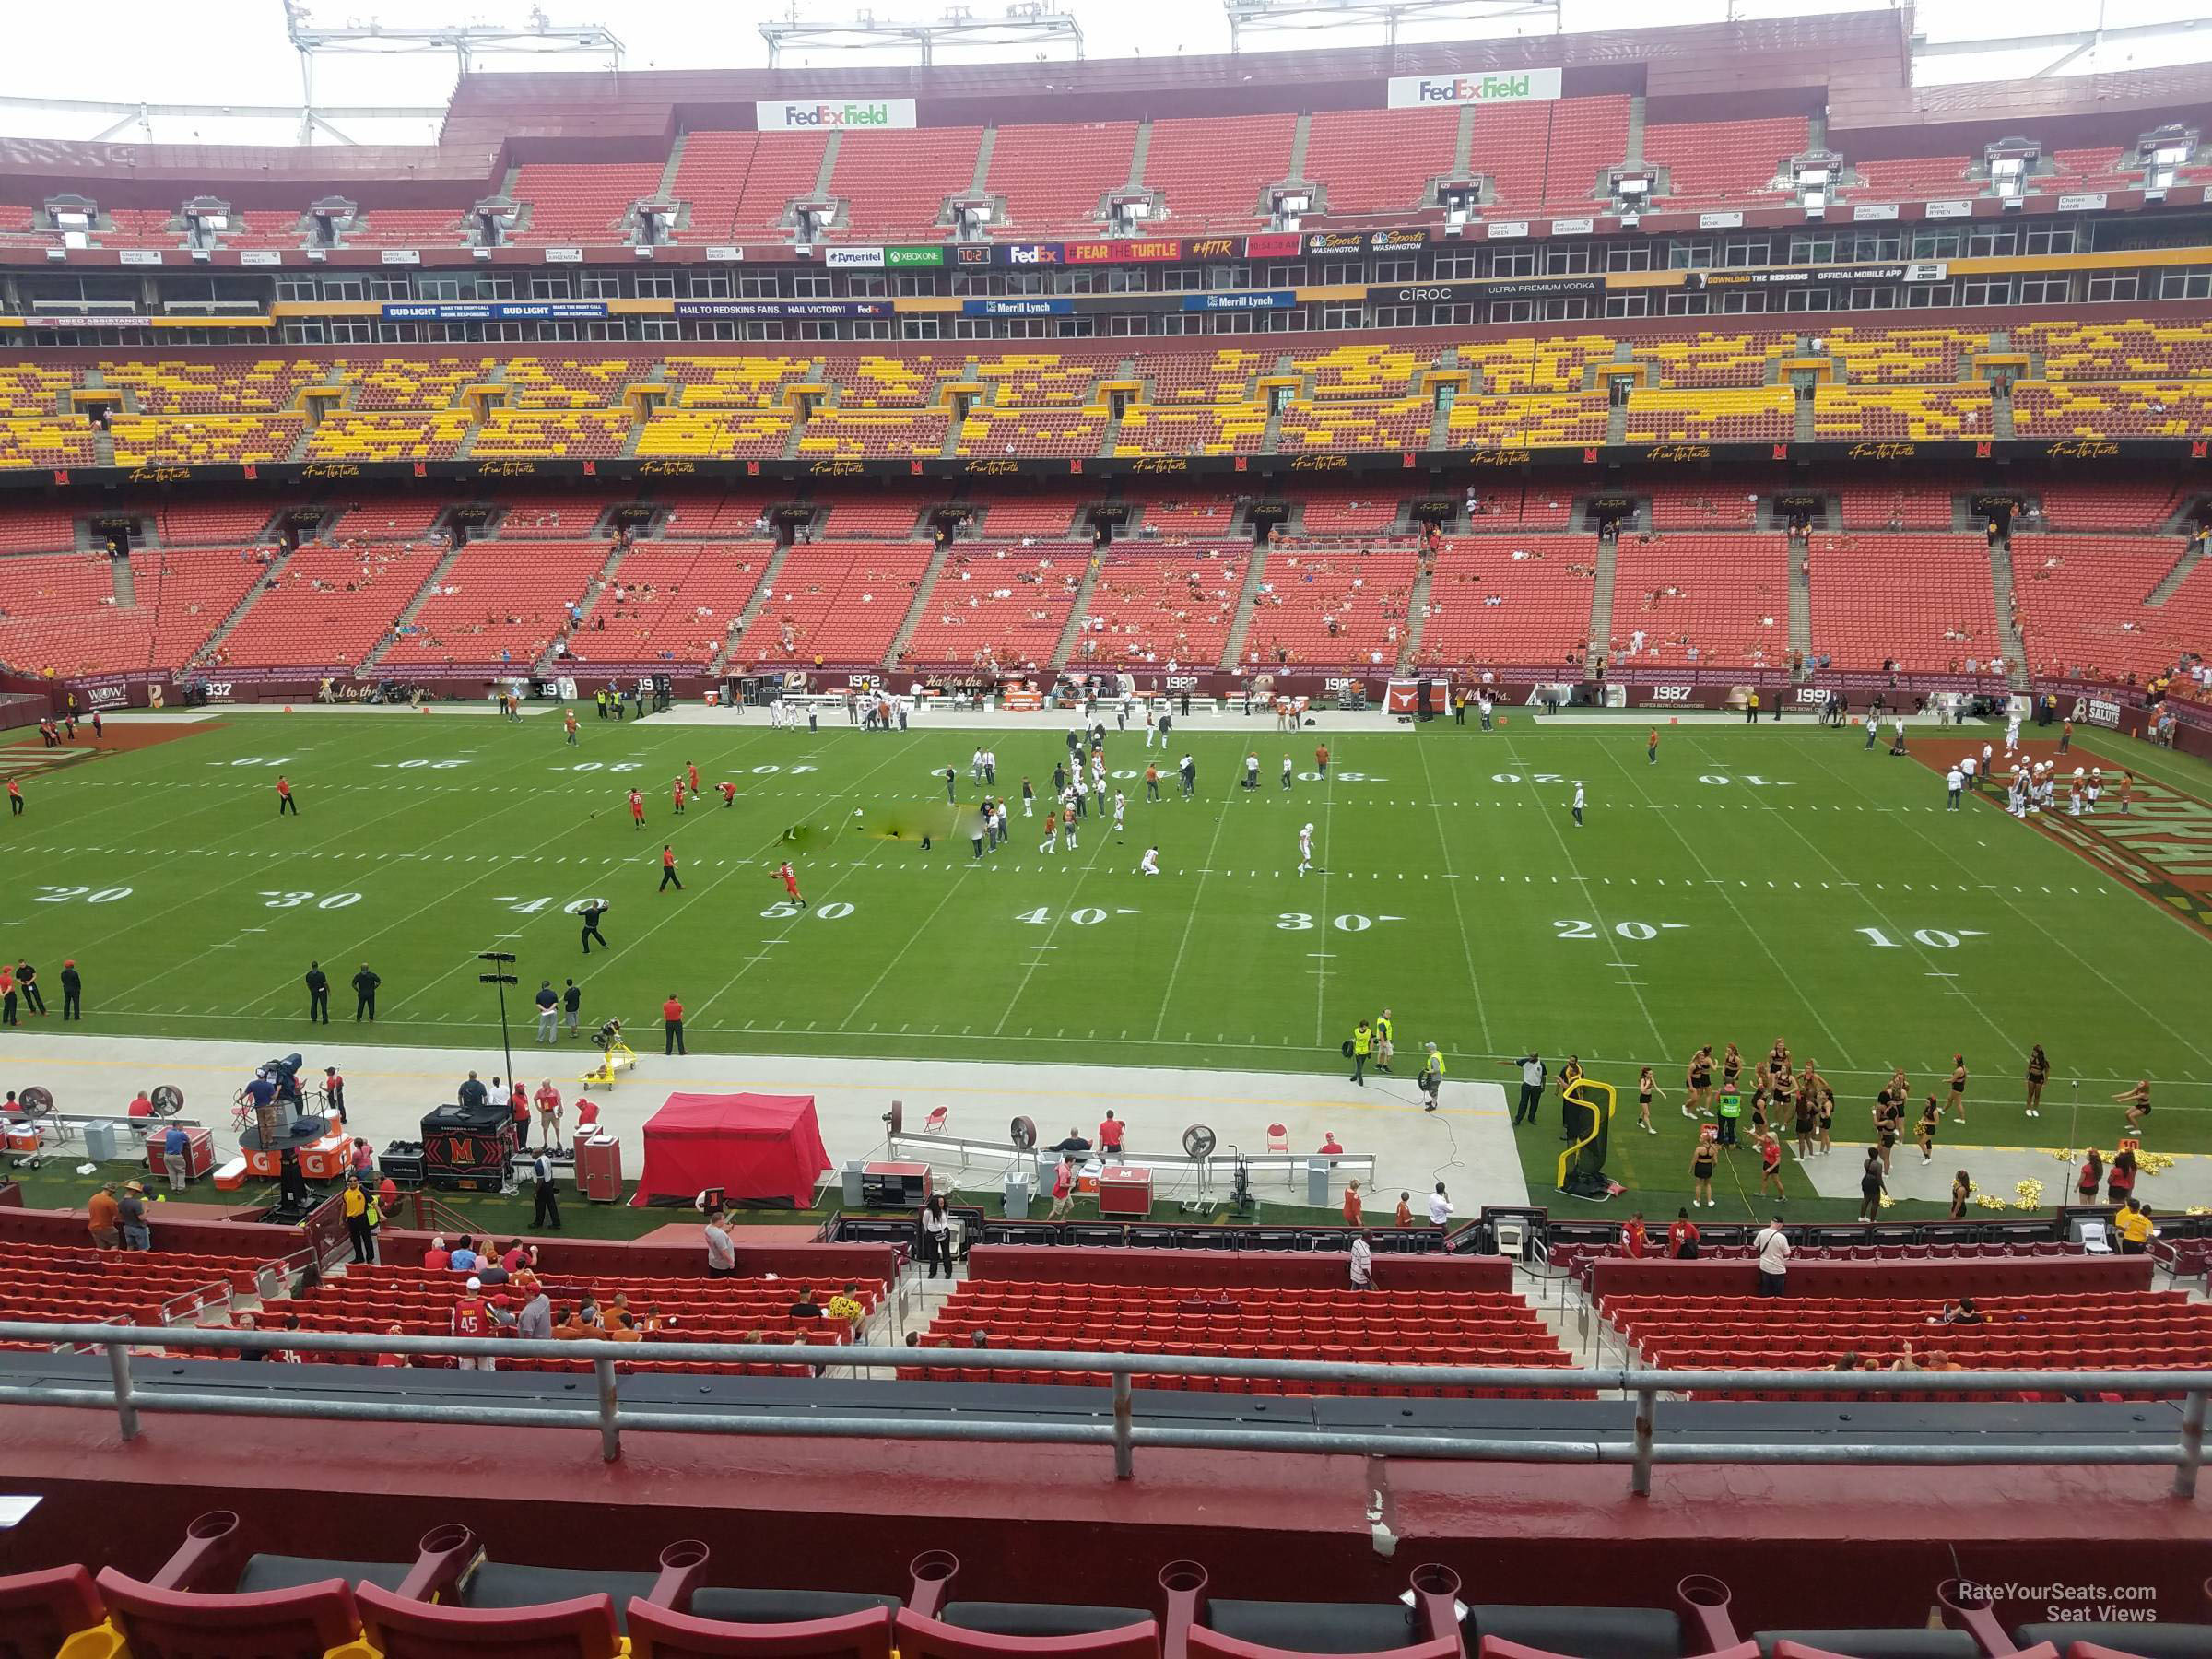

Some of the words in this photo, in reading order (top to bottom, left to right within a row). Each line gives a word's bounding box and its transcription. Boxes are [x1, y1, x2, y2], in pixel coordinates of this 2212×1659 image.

[1419, 75, 1529, 101] FedExField
[785, 104, 887, 125] FedExField
[1325, 233, 1363, 248] Sports
[1387, 230, 1426, 245] Sports
[837, 252, 881, 263] Ameritel
[921, 252, 939, 261] ONE
[1010, 245, 1057, 264] FedEx
[1707, 276, 1751, 285] DOWNLOAD
[1769, 273, 1809, 281] REDSKINS
[1818, 271, 1853, 279] OFFICIAL
[1854, 269, 1885, 278] MOBILE
[1885, 269, 1902, 277] APP
[1488, 286, 1517, 294] ULTRA
[1518, 283, 1561, 292] PREMIUM
[1563, 281, 1595, 290] VODKA
[997, 302, 1025, 312] Merrill
[1027, 301, 1050, 313] Lynch
[1218, 296, 1247, 307] Merrill
[1249, 295, 1273, 307] Lynch
[390, 308, 409, 316] BUD
[410, 308, 437, 316] LIGHT
[680, 306, 700, 314] HAIL
[700, 306, 712, 314] TO
[714, 306, 756, 314] REDSKINS
[757, 306, 782, 314] FANS.
[788, 306, 807, 314] HAIL
[807, 306, 846, 314] VICTORY!
[857, 305, 882, 313] FedEx
[1583, 448, 1598, 463] M
[1772, 443, 1788, 460] M
[1976, 441, 1992, 458] M
[2191, 441, 2208, 458] M
[911, 460, 924, 475] M
[1070, 459, 1082, 474] M
[1234, 456, 1248, 472] M
[1403, 453, 1416, 468] M
[243, 465, 258, 480] M
[414, 463, 428, 477] M
[582, 461, 596, 476] M
[747, 461, 759, 476] M
[54, 470, 70, 485] M
[965, 674, 982, 687] the
[347, 685, 358, 697] to
[1653, 686, 1692, 700] 1987
[1796, 688, 1830, 703] 1991
[2088, 707, 2120, 724] SALUTE
[33, 887, 134, 903] 20
[265, 891, 362, 909] 30
[759, 901, 855, 920] 50
[1015, 906, 1107, 924] 40
[1277, 912, 1371, 932] 30
[1553, 920, 1658, 941] 20
[1855, 927, 1959, 948] 10
[449, 1137, 475, 1161] M
[253, 1152, 269, 1171] G
[306, 1155, 324, 1173] G
[1677, 1229, 1685, 1237] M
[460, 1315, 478, 1333] 45
